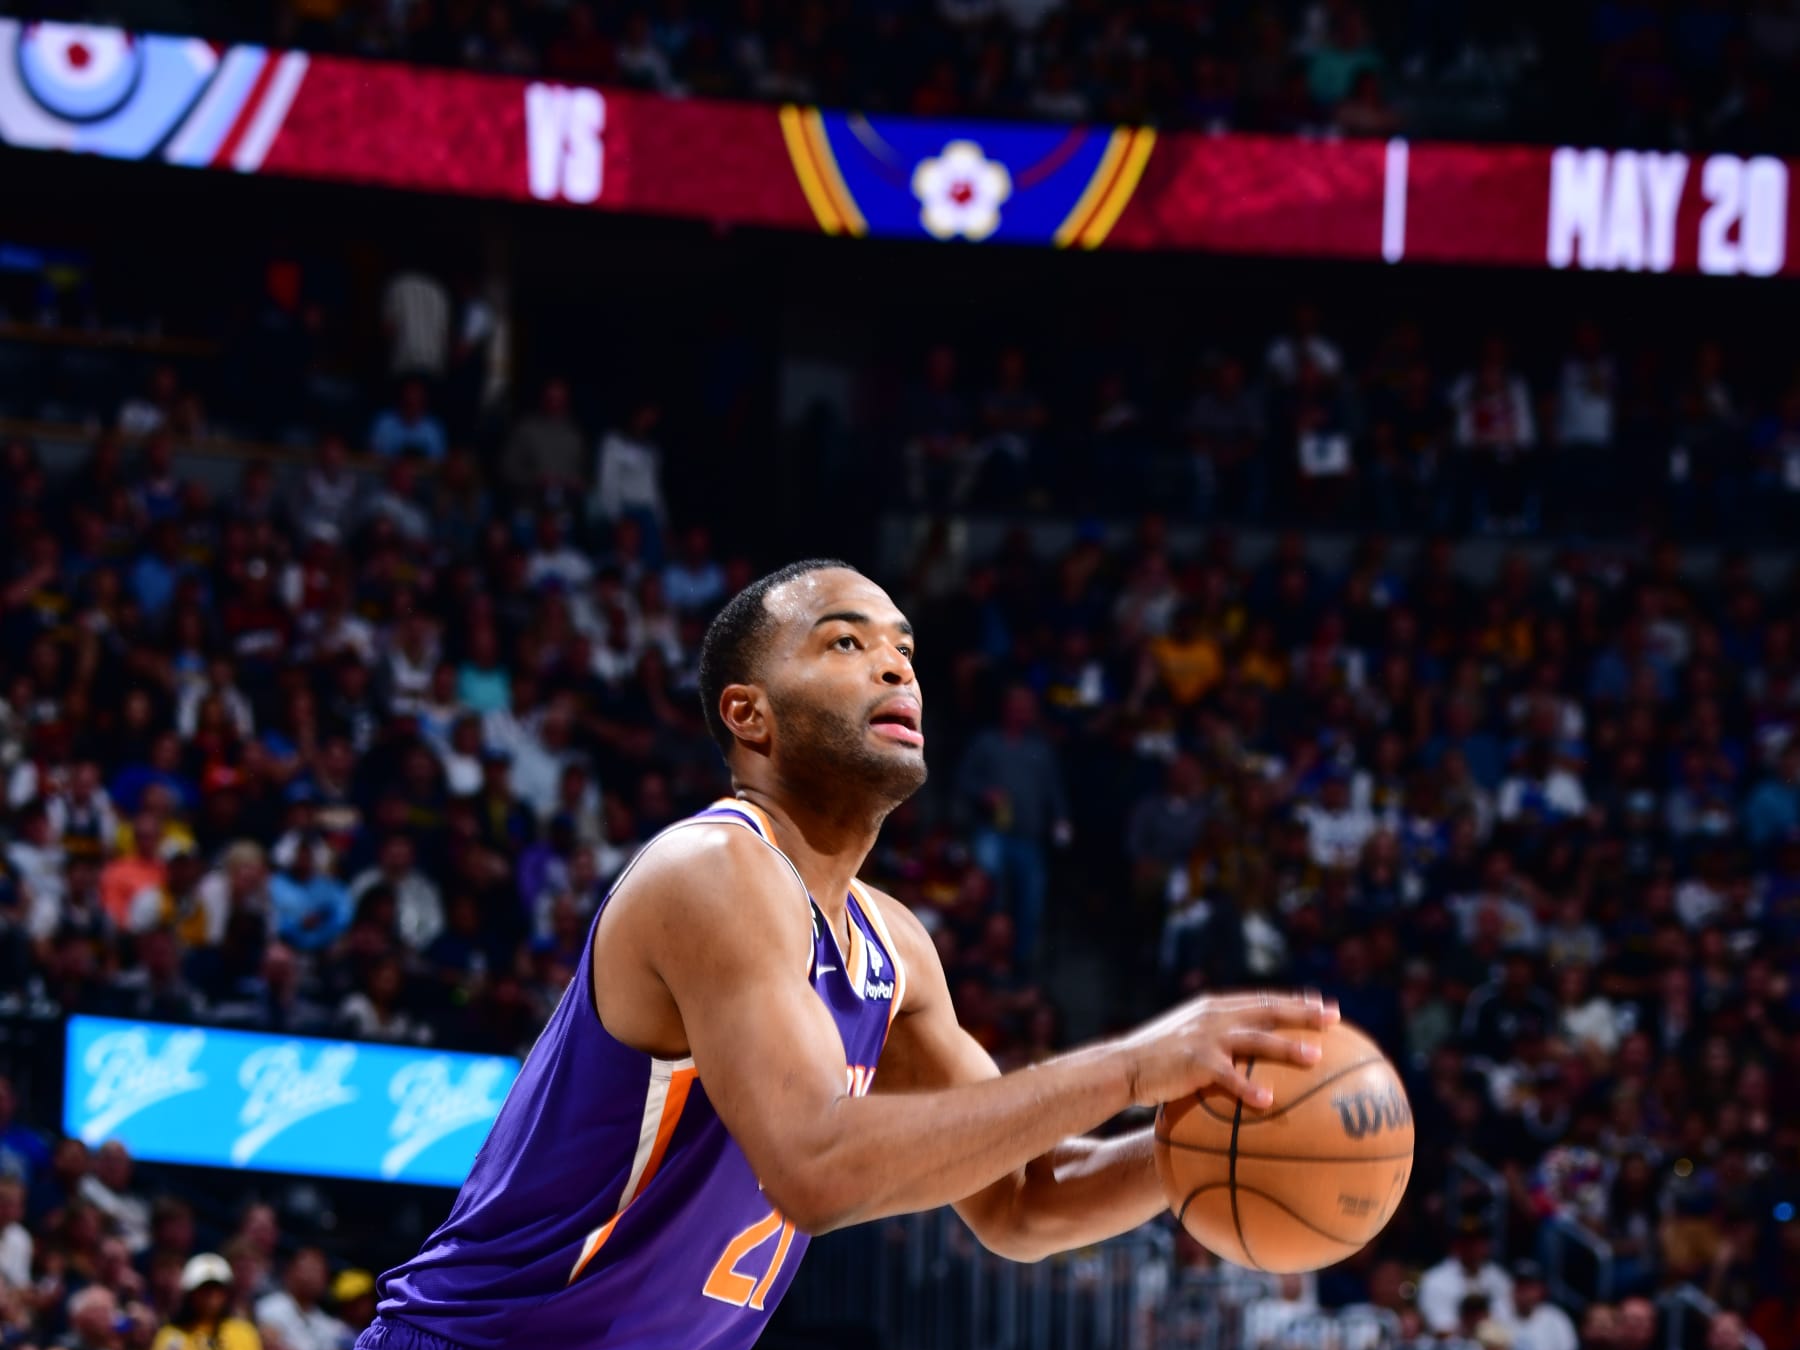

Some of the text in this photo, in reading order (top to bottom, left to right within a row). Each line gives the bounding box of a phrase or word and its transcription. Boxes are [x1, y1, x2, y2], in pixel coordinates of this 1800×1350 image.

[526, 83, 605, 203] VS
[1547, 147, 1788, 276] MAY 20
[865, 979, 894, 1001] PayPal
[81, 1027, 206, 1144] Ball
[231, 1043, 358, 1166] Ball
[702, 1207, 797, 1311] 21
